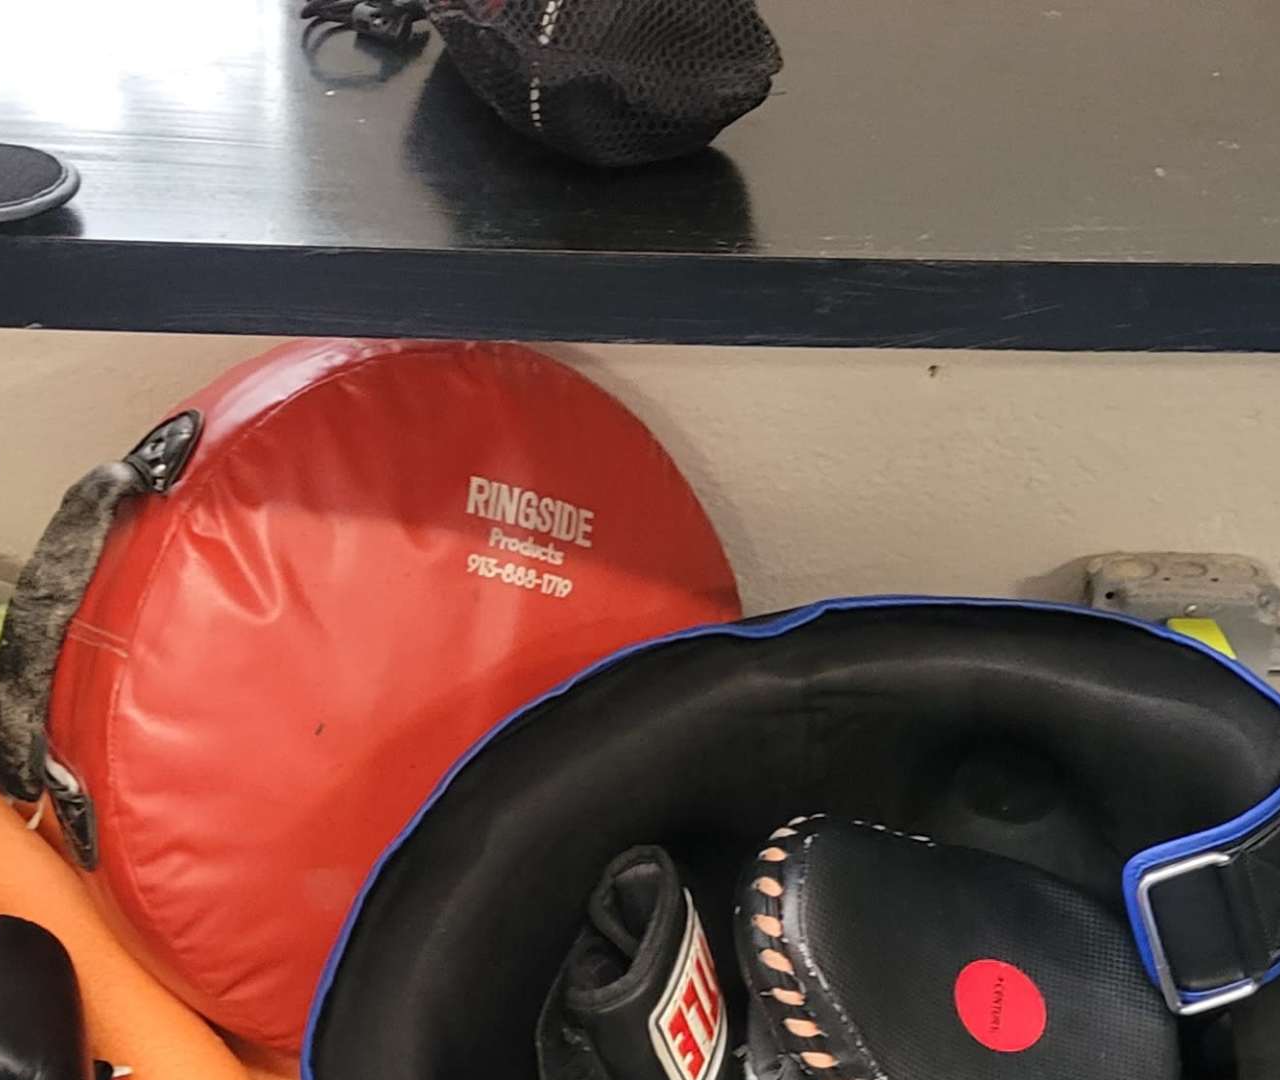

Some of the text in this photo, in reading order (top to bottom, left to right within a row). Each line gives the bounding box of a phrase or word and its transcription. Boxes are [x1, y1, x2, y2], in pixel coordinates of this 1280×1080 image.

[466, 476, 594, 548] RINGSIDE
[489, 527, 564, 565] Products
[467, 554, 573, 598] 913-888-1719
